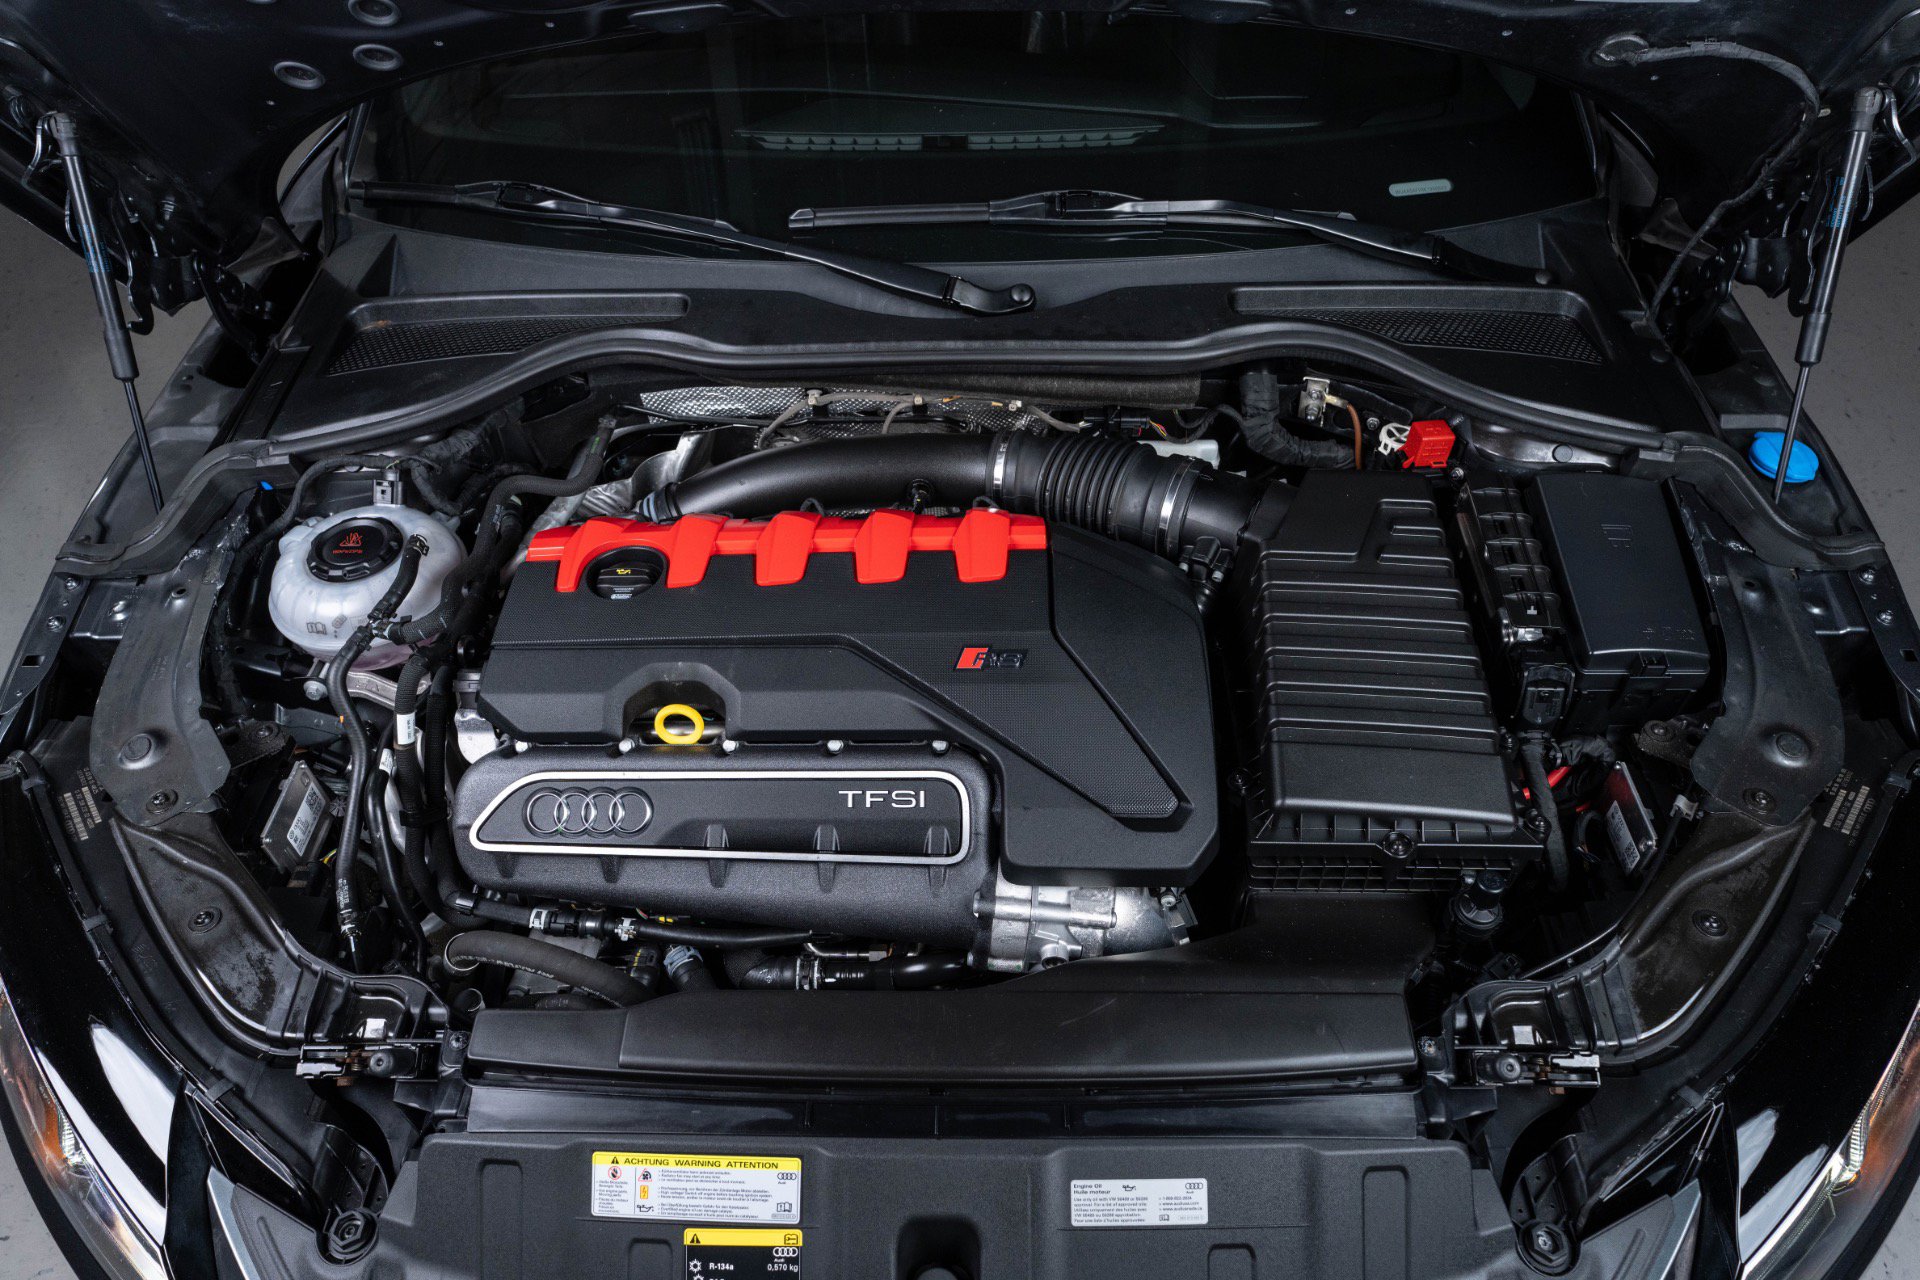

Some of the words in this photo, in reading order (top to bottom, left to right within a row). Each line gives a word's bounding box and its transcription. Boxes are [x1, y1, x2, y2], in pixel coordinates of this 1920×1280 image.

[838, 790, 925, 808] TFSI
[623, 1157, 670, 1166] ACHTUNG
[674, 1159, 721, 1168] WARNING
[726, 1161, 779, 1169] ATTENTION
[708, 1262, 734, 1270] R-134a
[789, 1263, 799, 1272] kg
